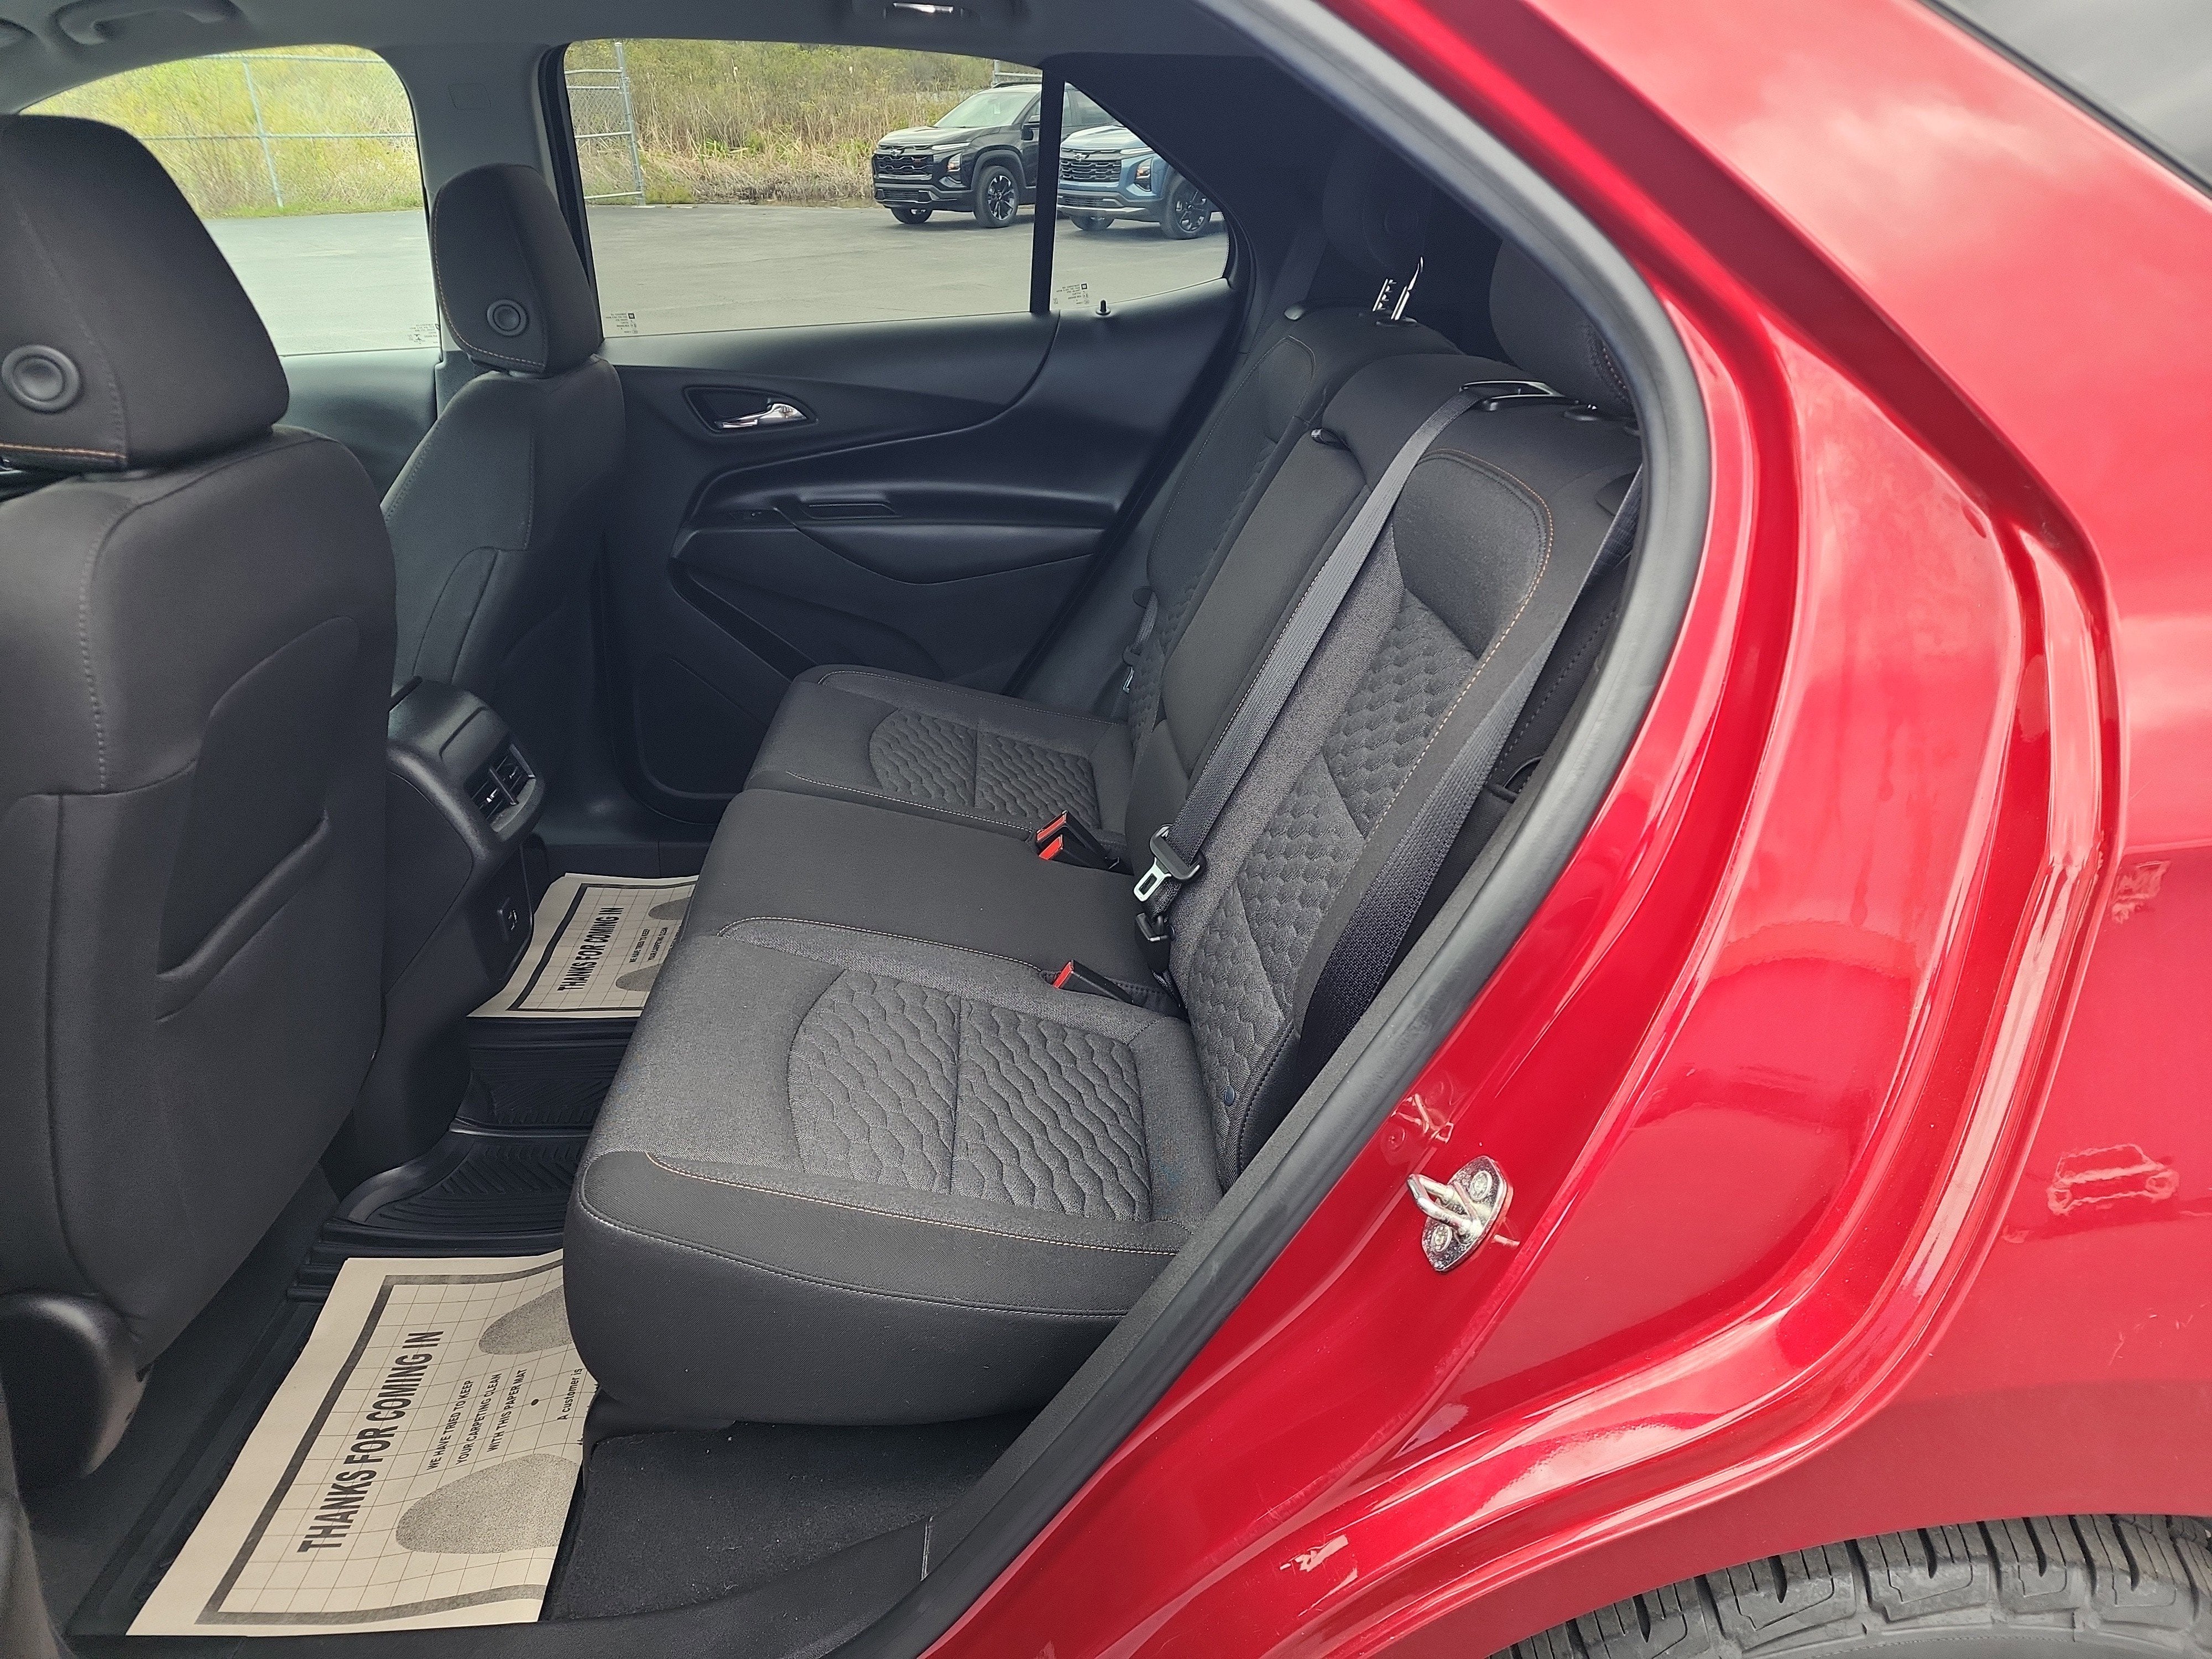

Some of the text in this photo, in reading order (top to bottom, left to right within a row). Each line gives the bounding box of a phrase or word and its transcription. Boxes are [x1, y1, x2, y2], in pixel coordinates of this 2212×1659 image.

[575, 945, 606, 960] FOR
[583, 916, 619, 942] COMING
[556, 962, 597, 991] THANKS
[455, 1373, 502, 1465] YOUR CARPETING CLEAN
[487, 1369, 527, 1452] WITH THIS PAPER MAT
[561, 1378, 578, 1412] customer
[297, 1331, 445, 1552] THANKS FOR COMING IN
[426, 1380, 473, 1470] WE HAVE TRIED TO KEEP
